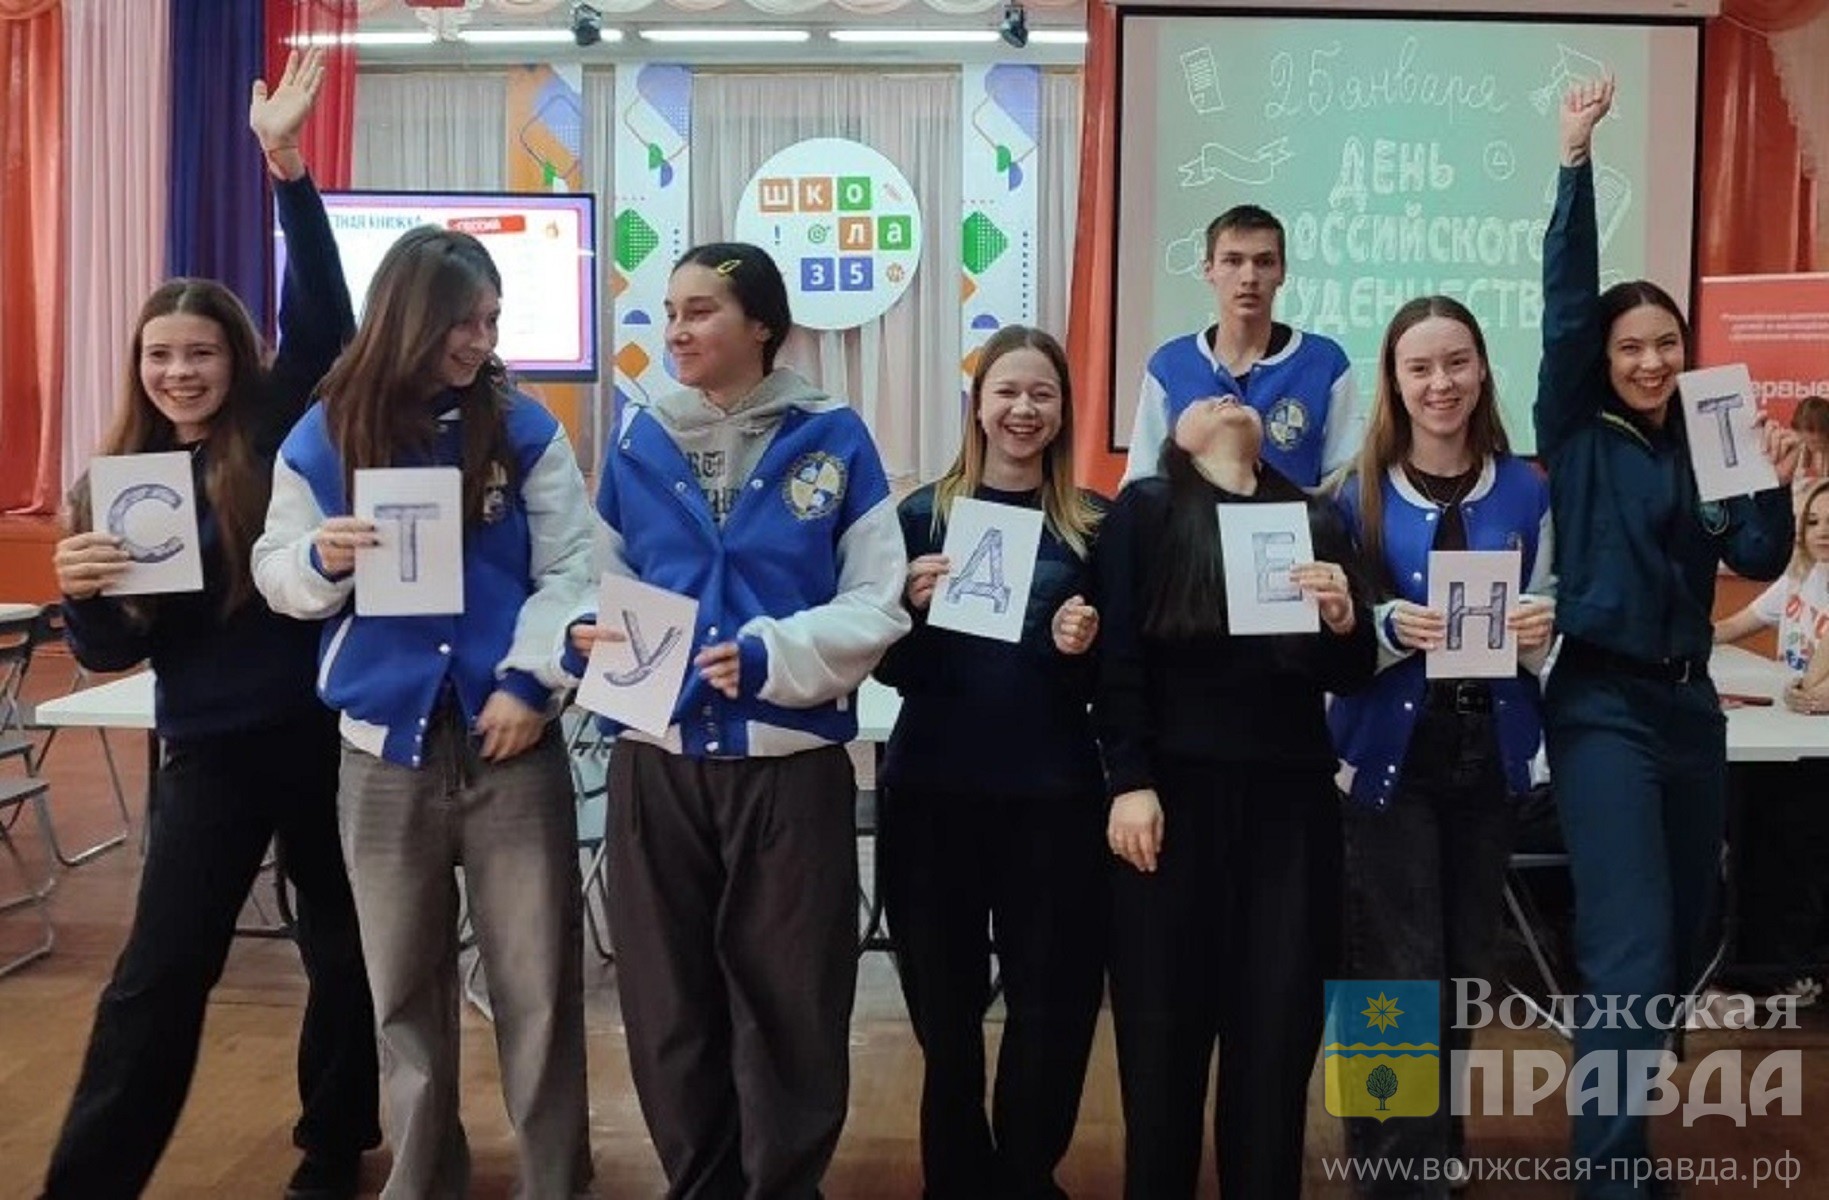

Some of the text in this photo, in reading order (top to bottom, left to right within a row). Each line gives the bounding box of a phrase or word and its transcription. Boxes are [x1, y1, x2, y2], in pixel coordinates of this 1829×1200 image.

[1264, 35, 1509, 125] 25 января
[1328, 135, 1455, 212] ДЕНЬ
[1284, 203, 1546, 266] ОССИЙСКОГО
[808, 262, 865, 286] 35
[1697, 393, 1744, 468] Т
[1750, 379, 1829, 406] ервые
[108, 483, 185, 564] С
[374, 503, 441, 583] Т
[946, 527, 1012, 615] Д
[1252, 531, 1306, 605] Е
[603, 608, 684, 688] У
[1445, 580, 1509, 652] Н
